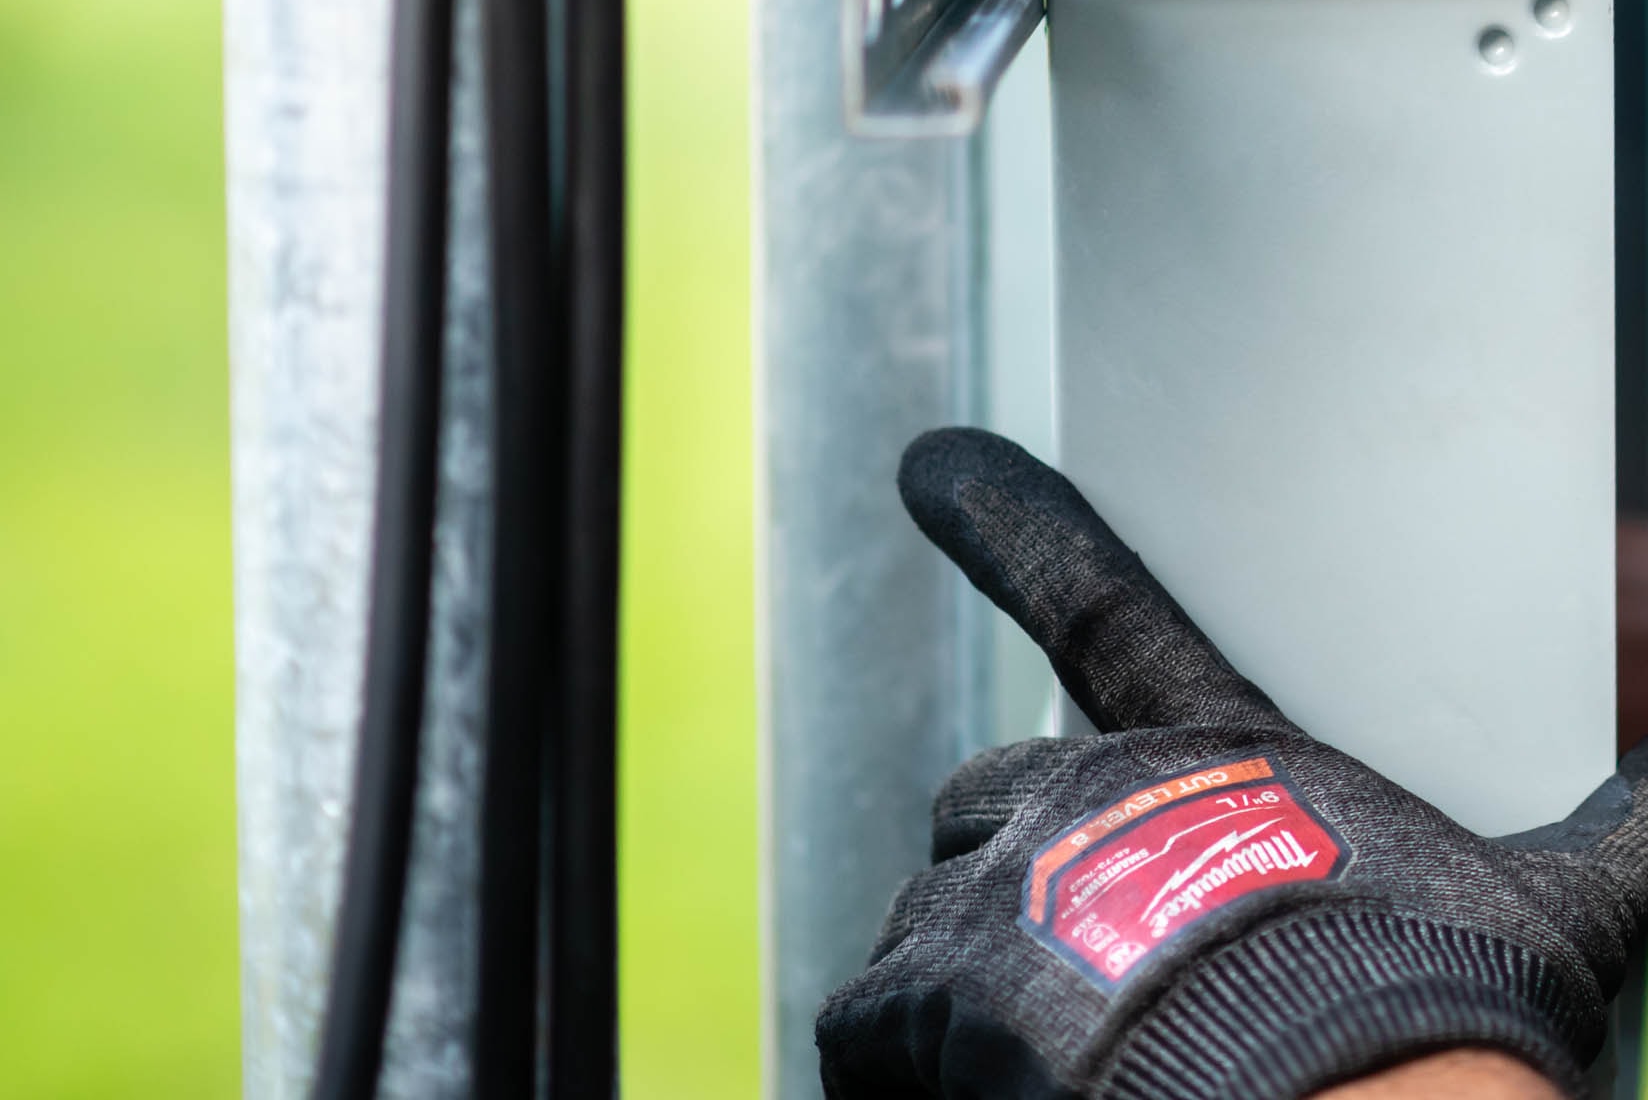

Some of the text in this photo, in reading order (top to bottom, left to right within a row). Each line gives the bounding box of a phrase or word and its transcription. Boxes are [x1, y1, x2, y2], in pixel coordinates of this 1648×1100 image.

[1180, 771, 1228, 793] CUT
[1089, 787, 1172, 828] LEVEL
[1149, 830, 1318, 932] Milwaukee
